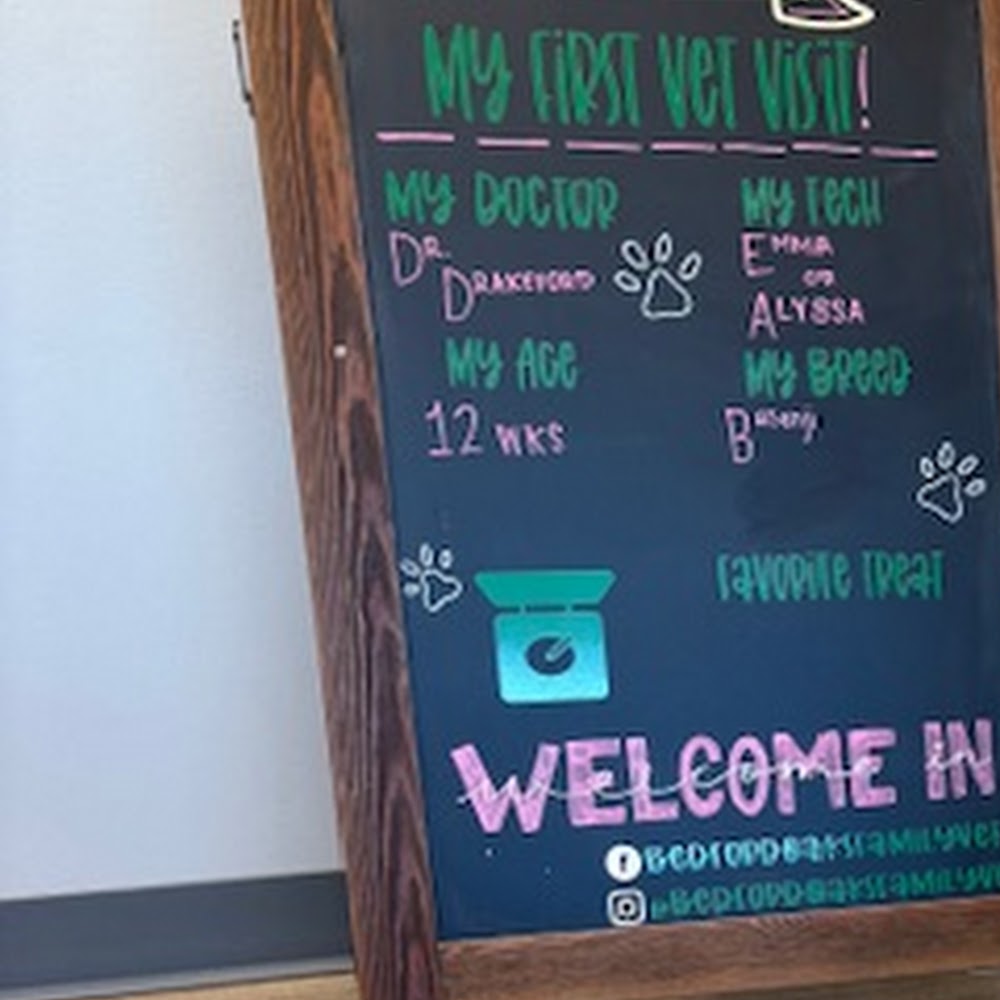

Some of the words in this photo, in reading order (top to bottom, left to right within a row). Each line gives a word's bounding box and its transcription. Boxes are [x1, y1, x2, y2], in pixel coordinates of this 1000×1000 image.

[474, 170, 619, 231] DOCTOR
[748, 291, 866, 340] ALYSSA
[424, 400, 485, 457] 12
[450, 727, 898, 836] WELCOME
[922, 719, 998, 801] IN
